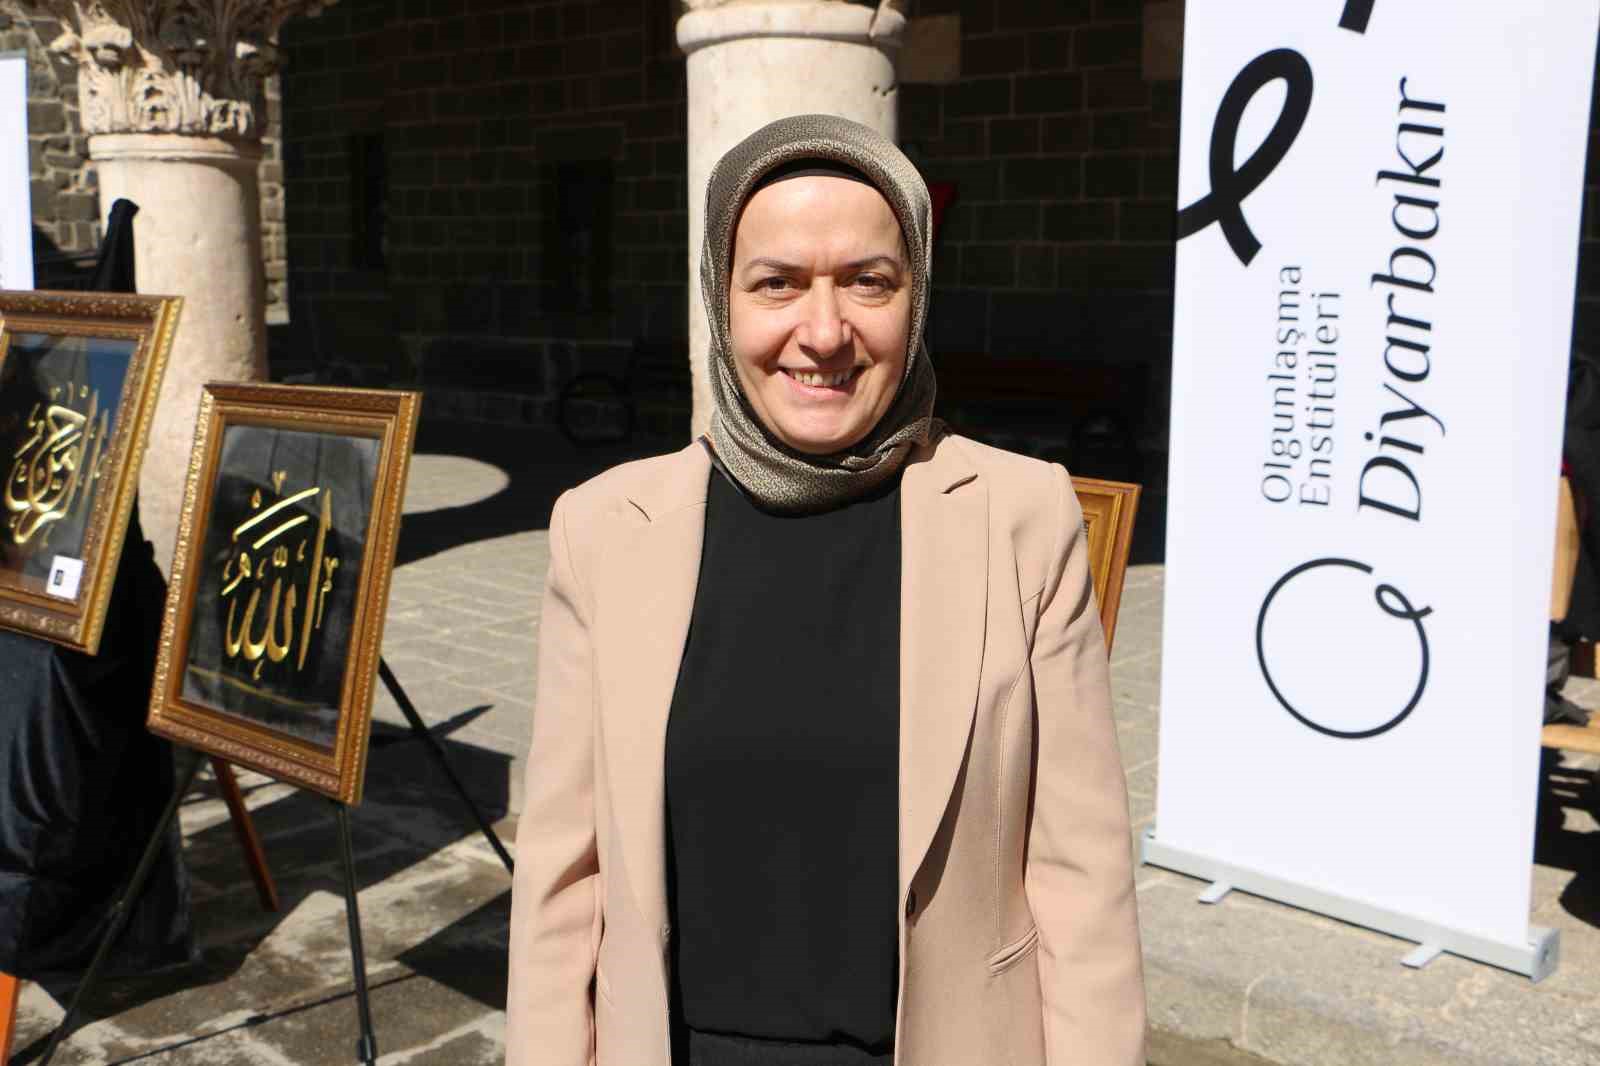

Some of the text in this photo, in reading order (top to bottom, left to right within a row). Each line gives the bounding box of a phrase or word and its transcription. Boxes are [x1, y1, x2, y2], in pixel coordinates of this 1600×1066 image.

[1261, 265, 1304, 503] Olgunlaşma
[1299, 291, 1340, 507] Enstitüleri
[1358, 76, 1446, 523] Diyarbakır
